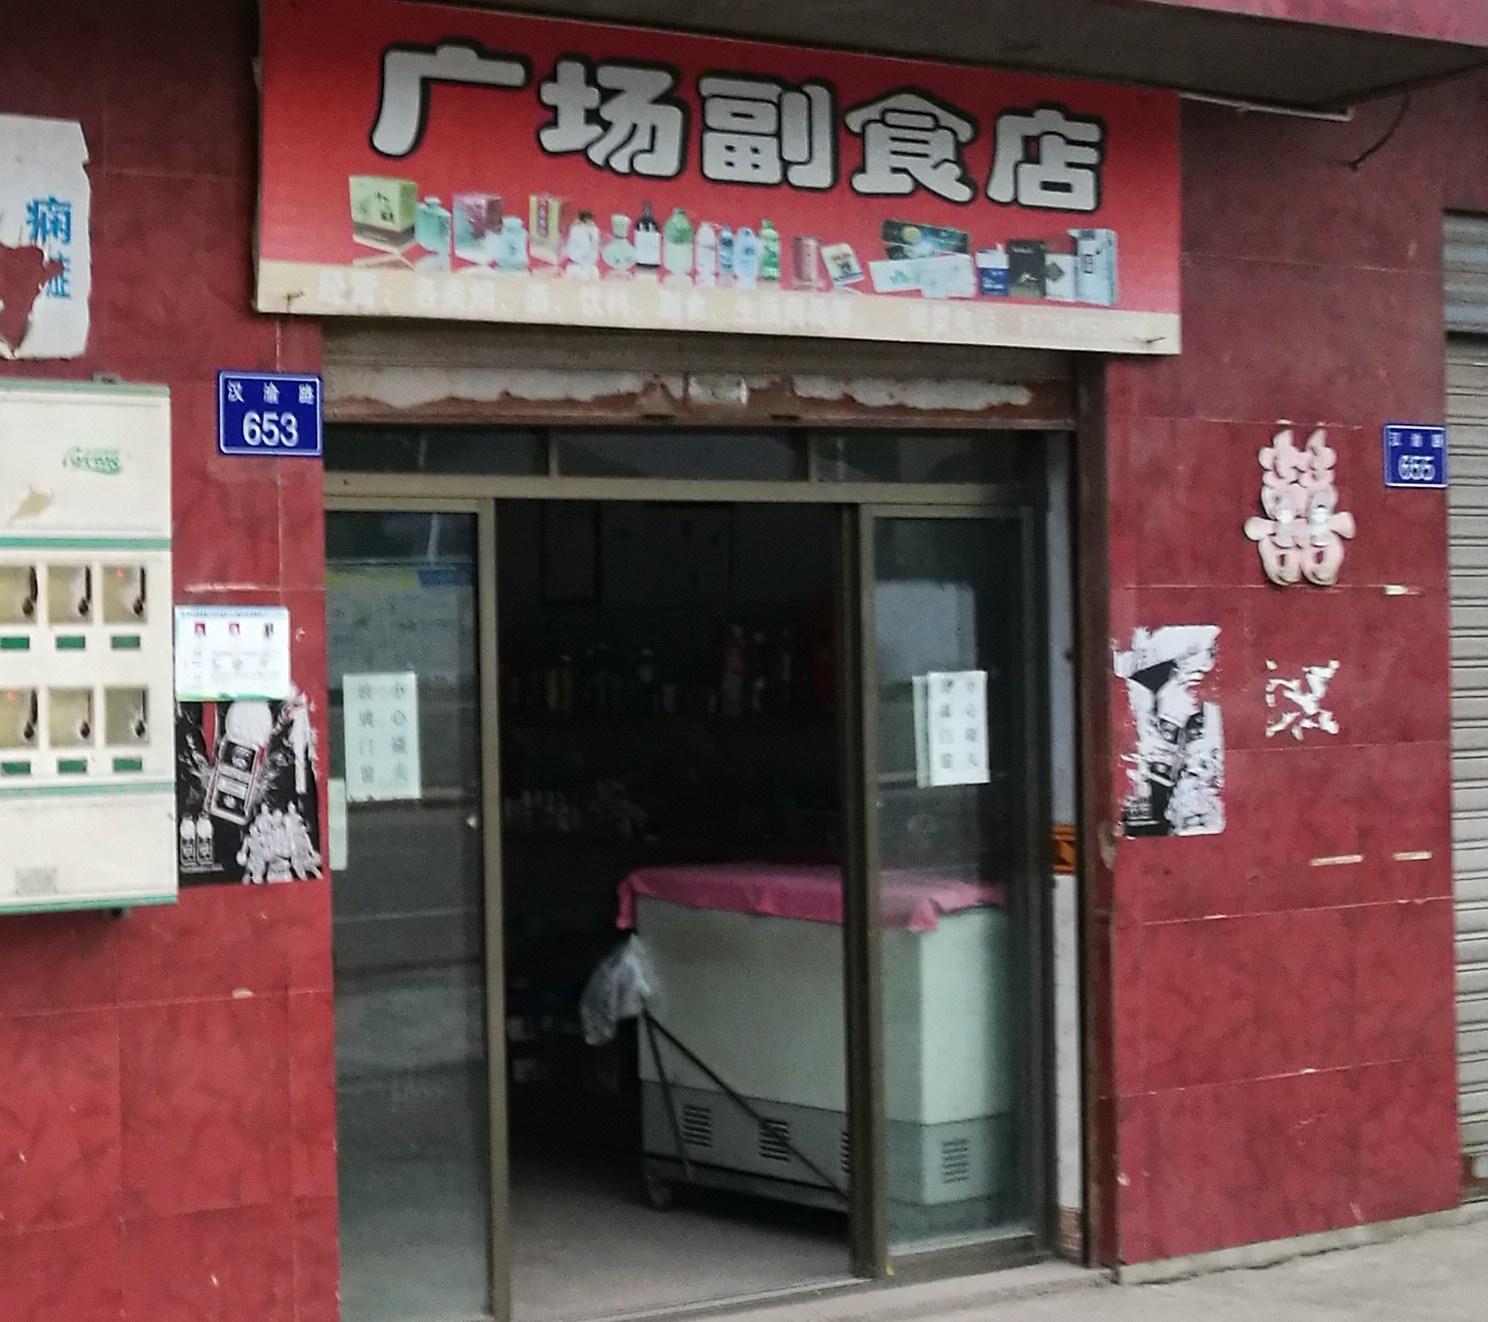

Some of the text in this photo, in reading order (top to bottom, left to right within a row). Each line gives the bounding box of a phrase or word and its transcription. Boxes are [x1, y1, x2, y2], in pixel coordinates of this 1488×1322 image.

[370, 38, 1106, 212] 广场副食店
[242, 410, 299, 447] 653
